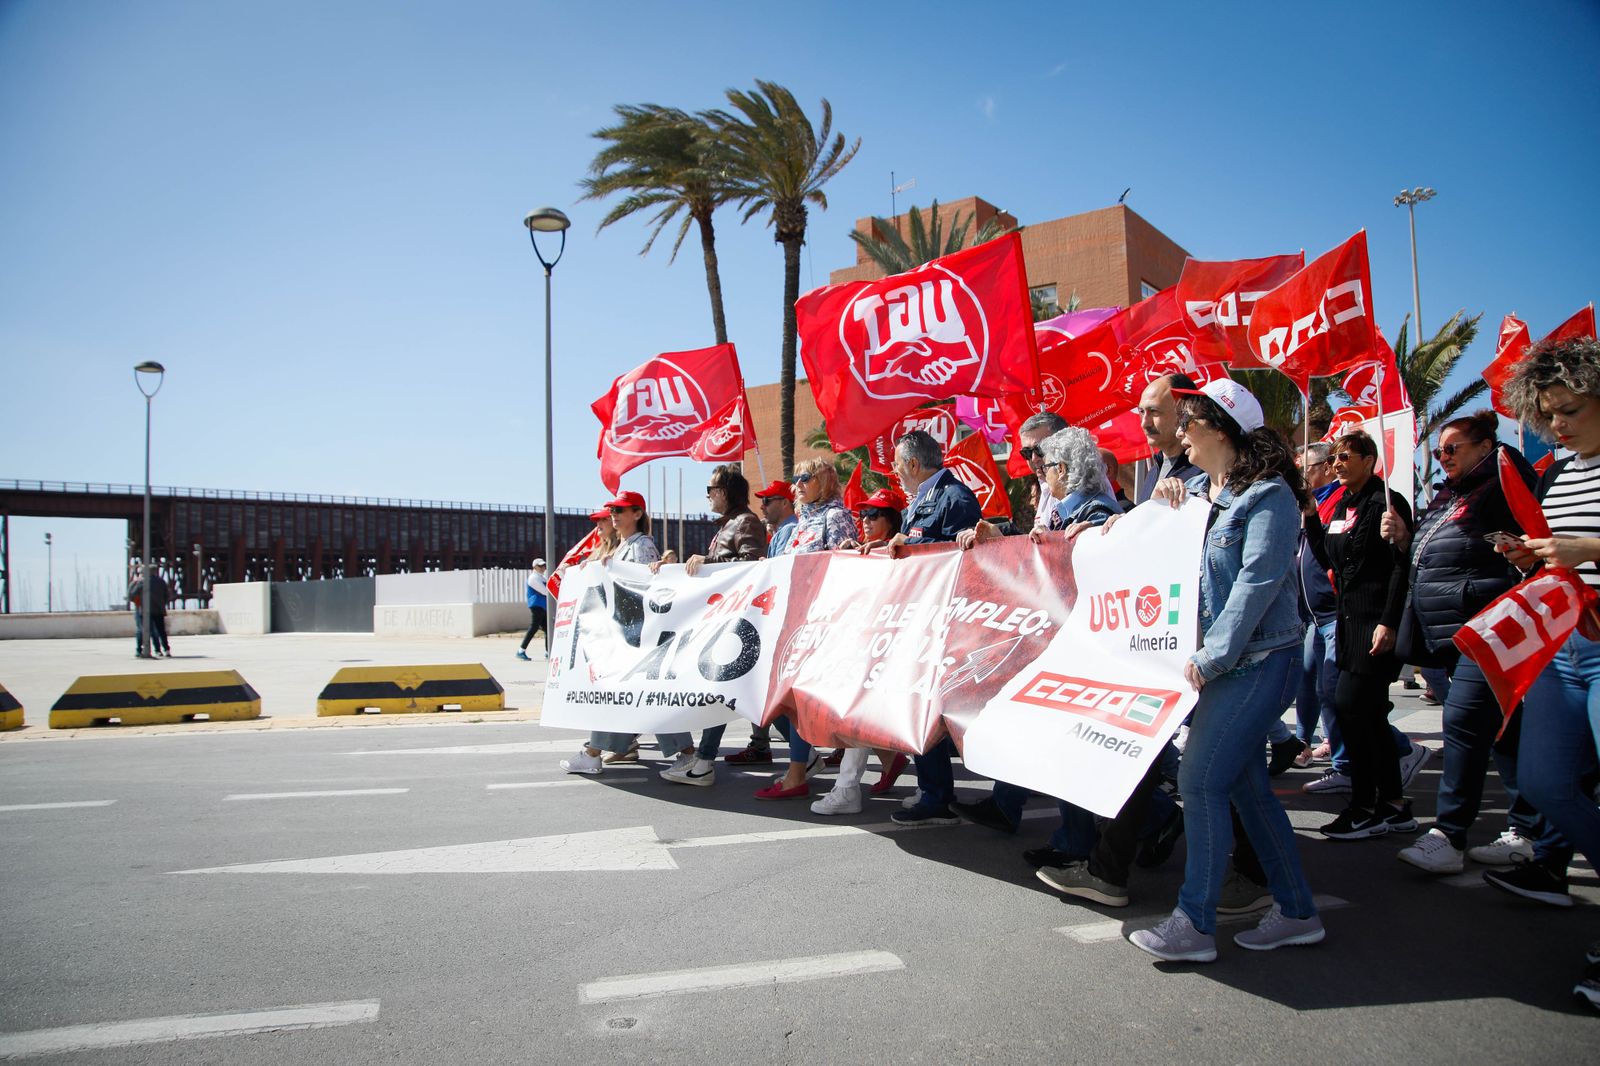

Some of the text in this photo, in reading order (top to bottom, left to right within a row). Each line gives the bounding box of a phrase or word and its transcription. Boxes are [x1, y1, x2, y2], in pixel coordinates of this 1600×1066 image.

[1089, 588, 1130, 633] UGT
[1129, 631, 1178, 652] Almería
[566, 691, 634, 706] #PLENOEMPLEO
[1024, 678, 1137, 717] CCOO
[1067, 721, 1144, 759] Almería
